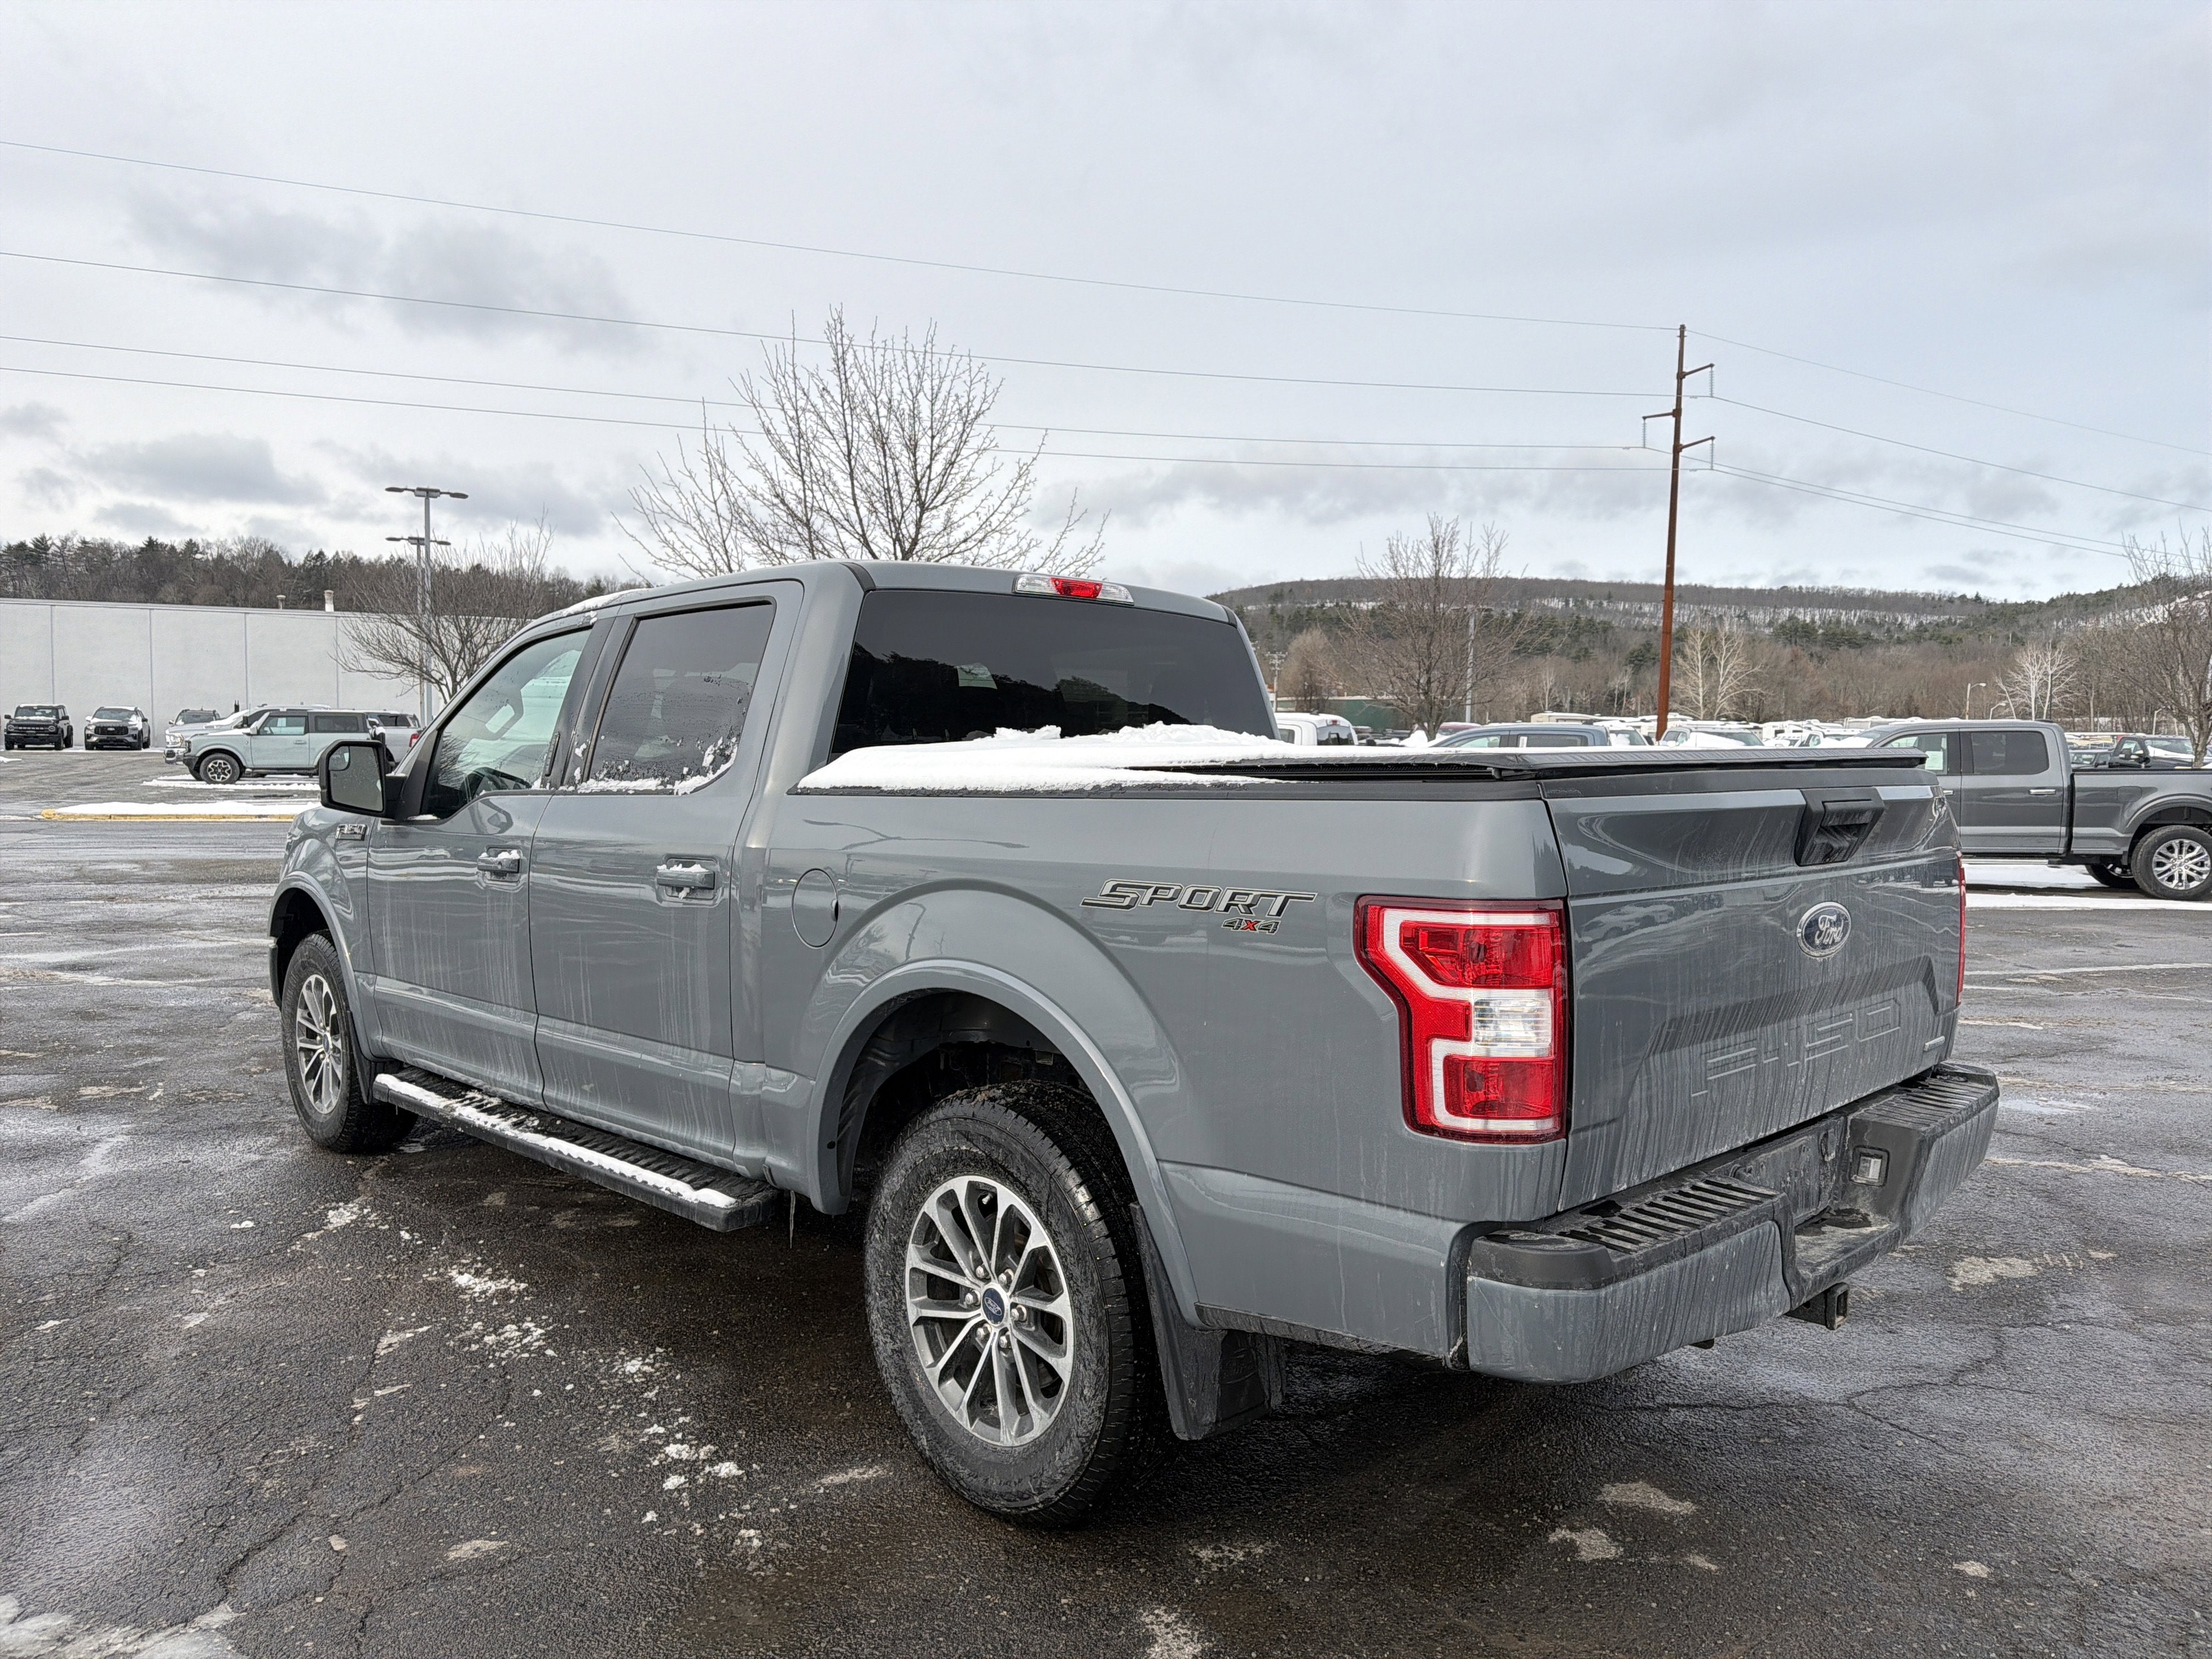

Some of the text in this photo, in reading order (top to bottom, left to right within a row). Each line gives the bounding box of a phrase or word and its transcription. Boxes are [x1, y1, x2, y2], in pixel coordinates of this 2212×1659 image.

[1080, 879, 1318, 918] SPORT
[1814, 915, 1844, 945] Ford
[1691, 997, 1900, 1097] F-150
